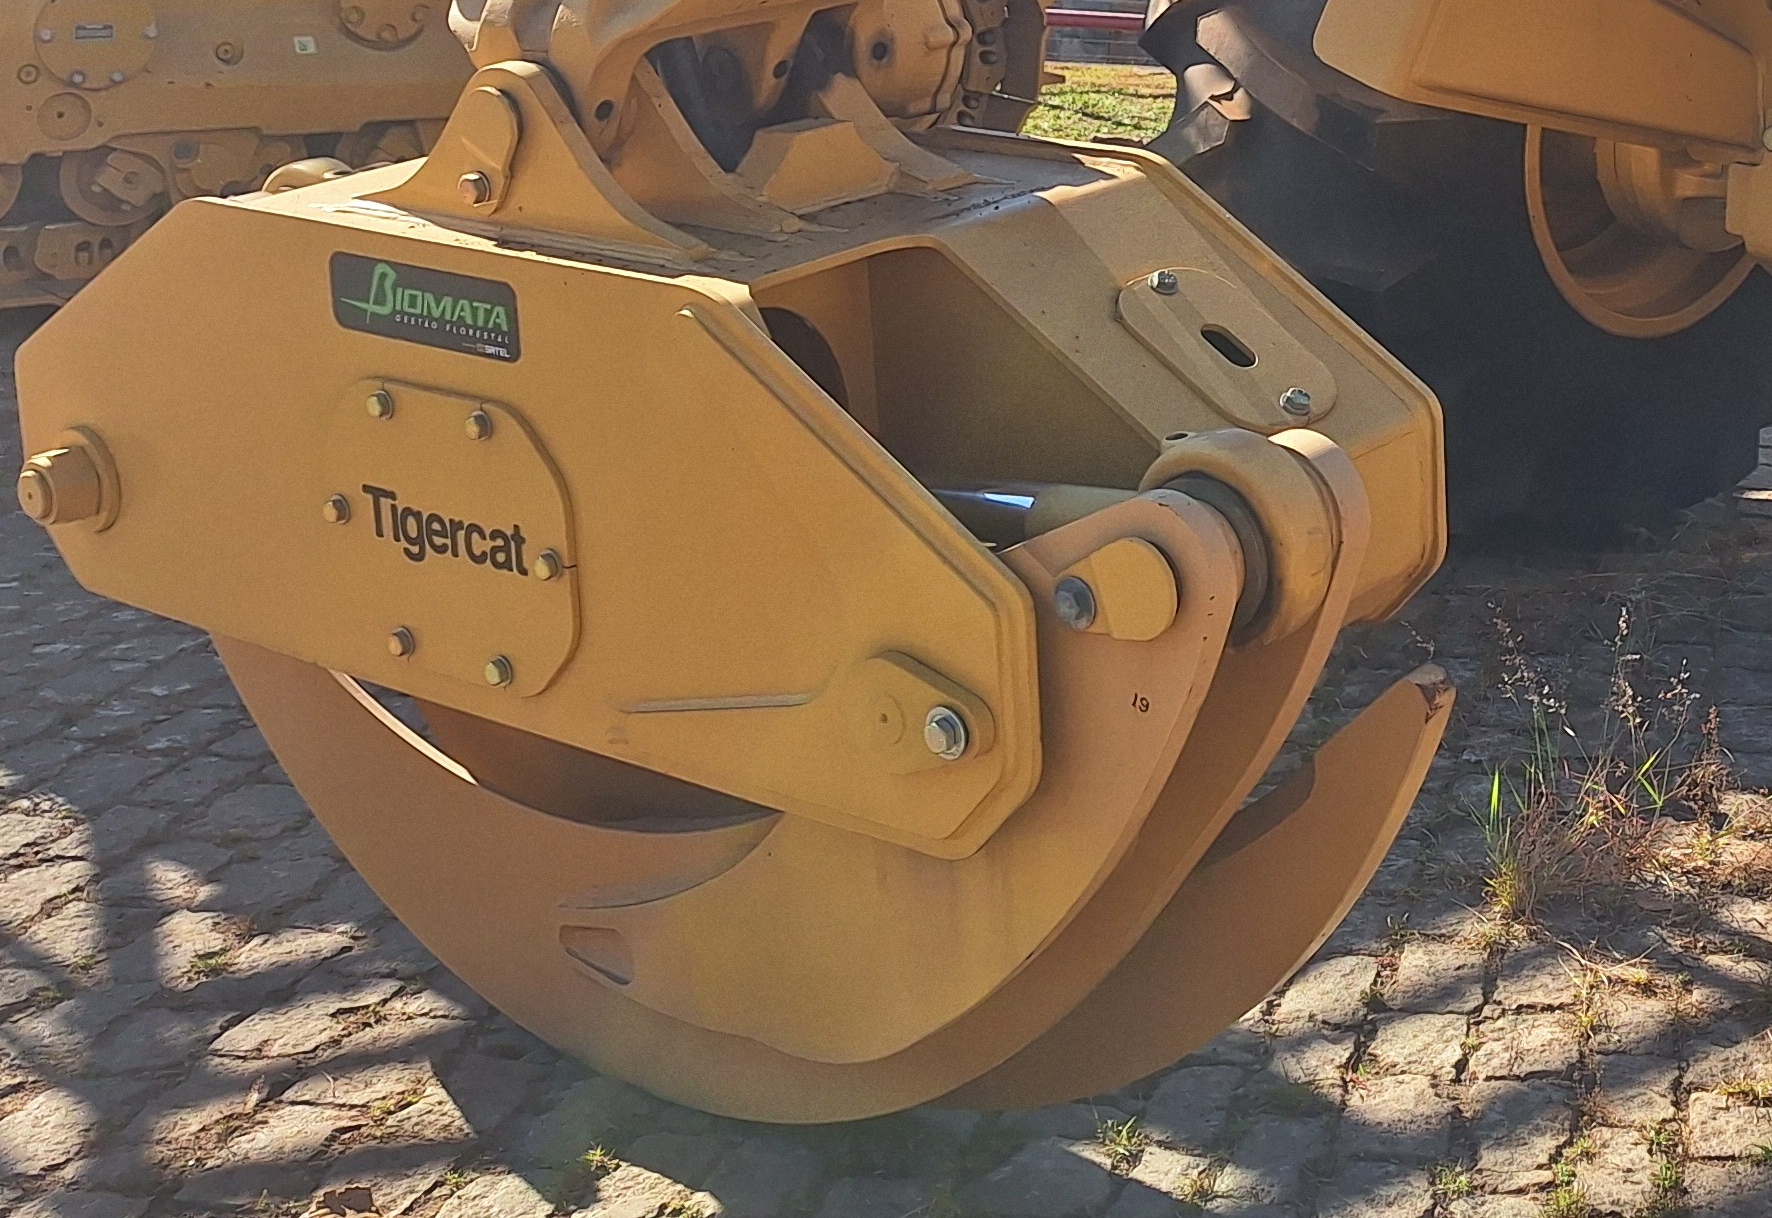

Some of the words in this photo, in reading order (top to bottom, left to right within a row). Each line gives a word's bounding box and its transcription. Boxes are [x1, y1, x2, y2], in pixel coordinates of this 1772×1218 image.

[340, 262, 509, 332] BIOMATA
[362, 484, 528, 576] Tigercat
[1131, 693, 1150, 712] 19
